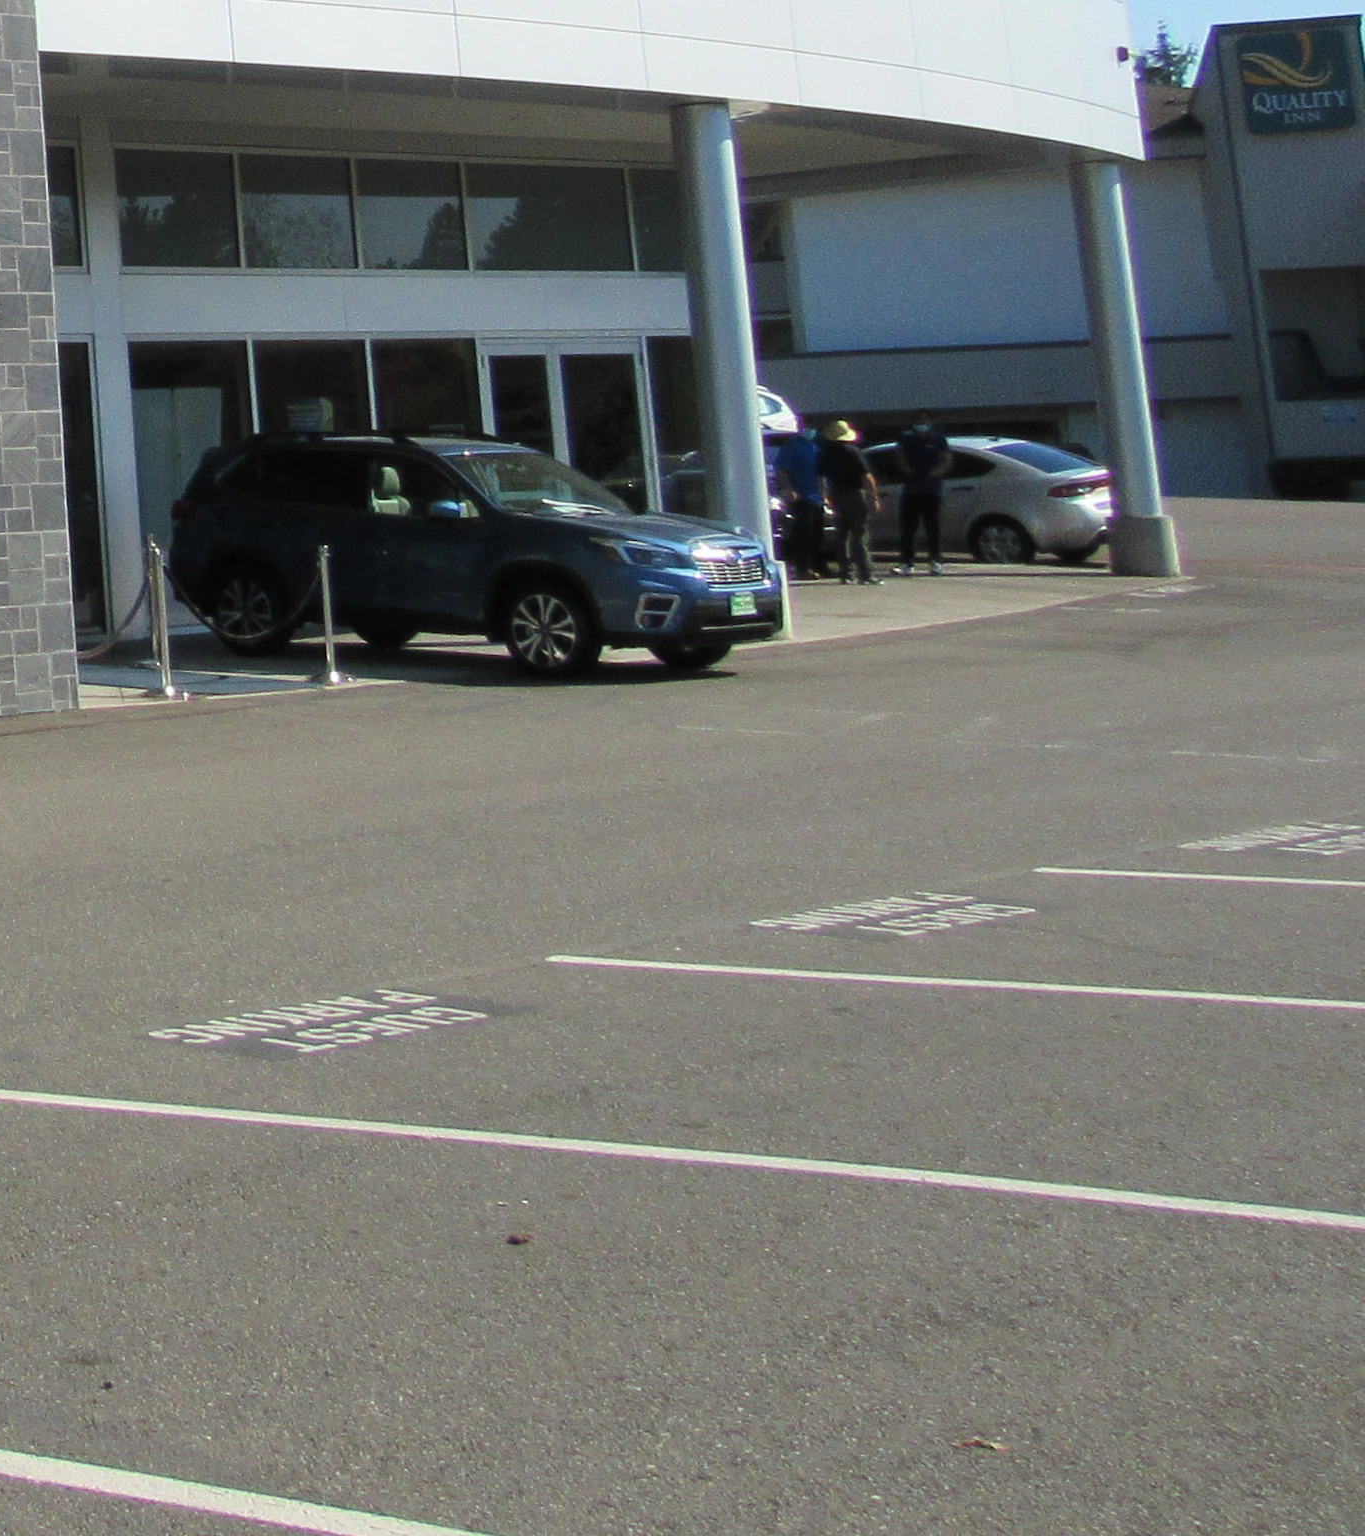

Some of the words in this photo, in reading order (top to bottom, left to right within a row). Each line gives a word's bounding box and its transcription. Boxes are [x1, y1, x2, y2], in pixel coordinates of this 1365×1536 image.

[1251, 89, 1348, 114] QUALITY
[1282, 111, 1322, 124] INN
[148, 989, 438, 1044] PARKING
[261, 1006, 488, 1053] GUEST
